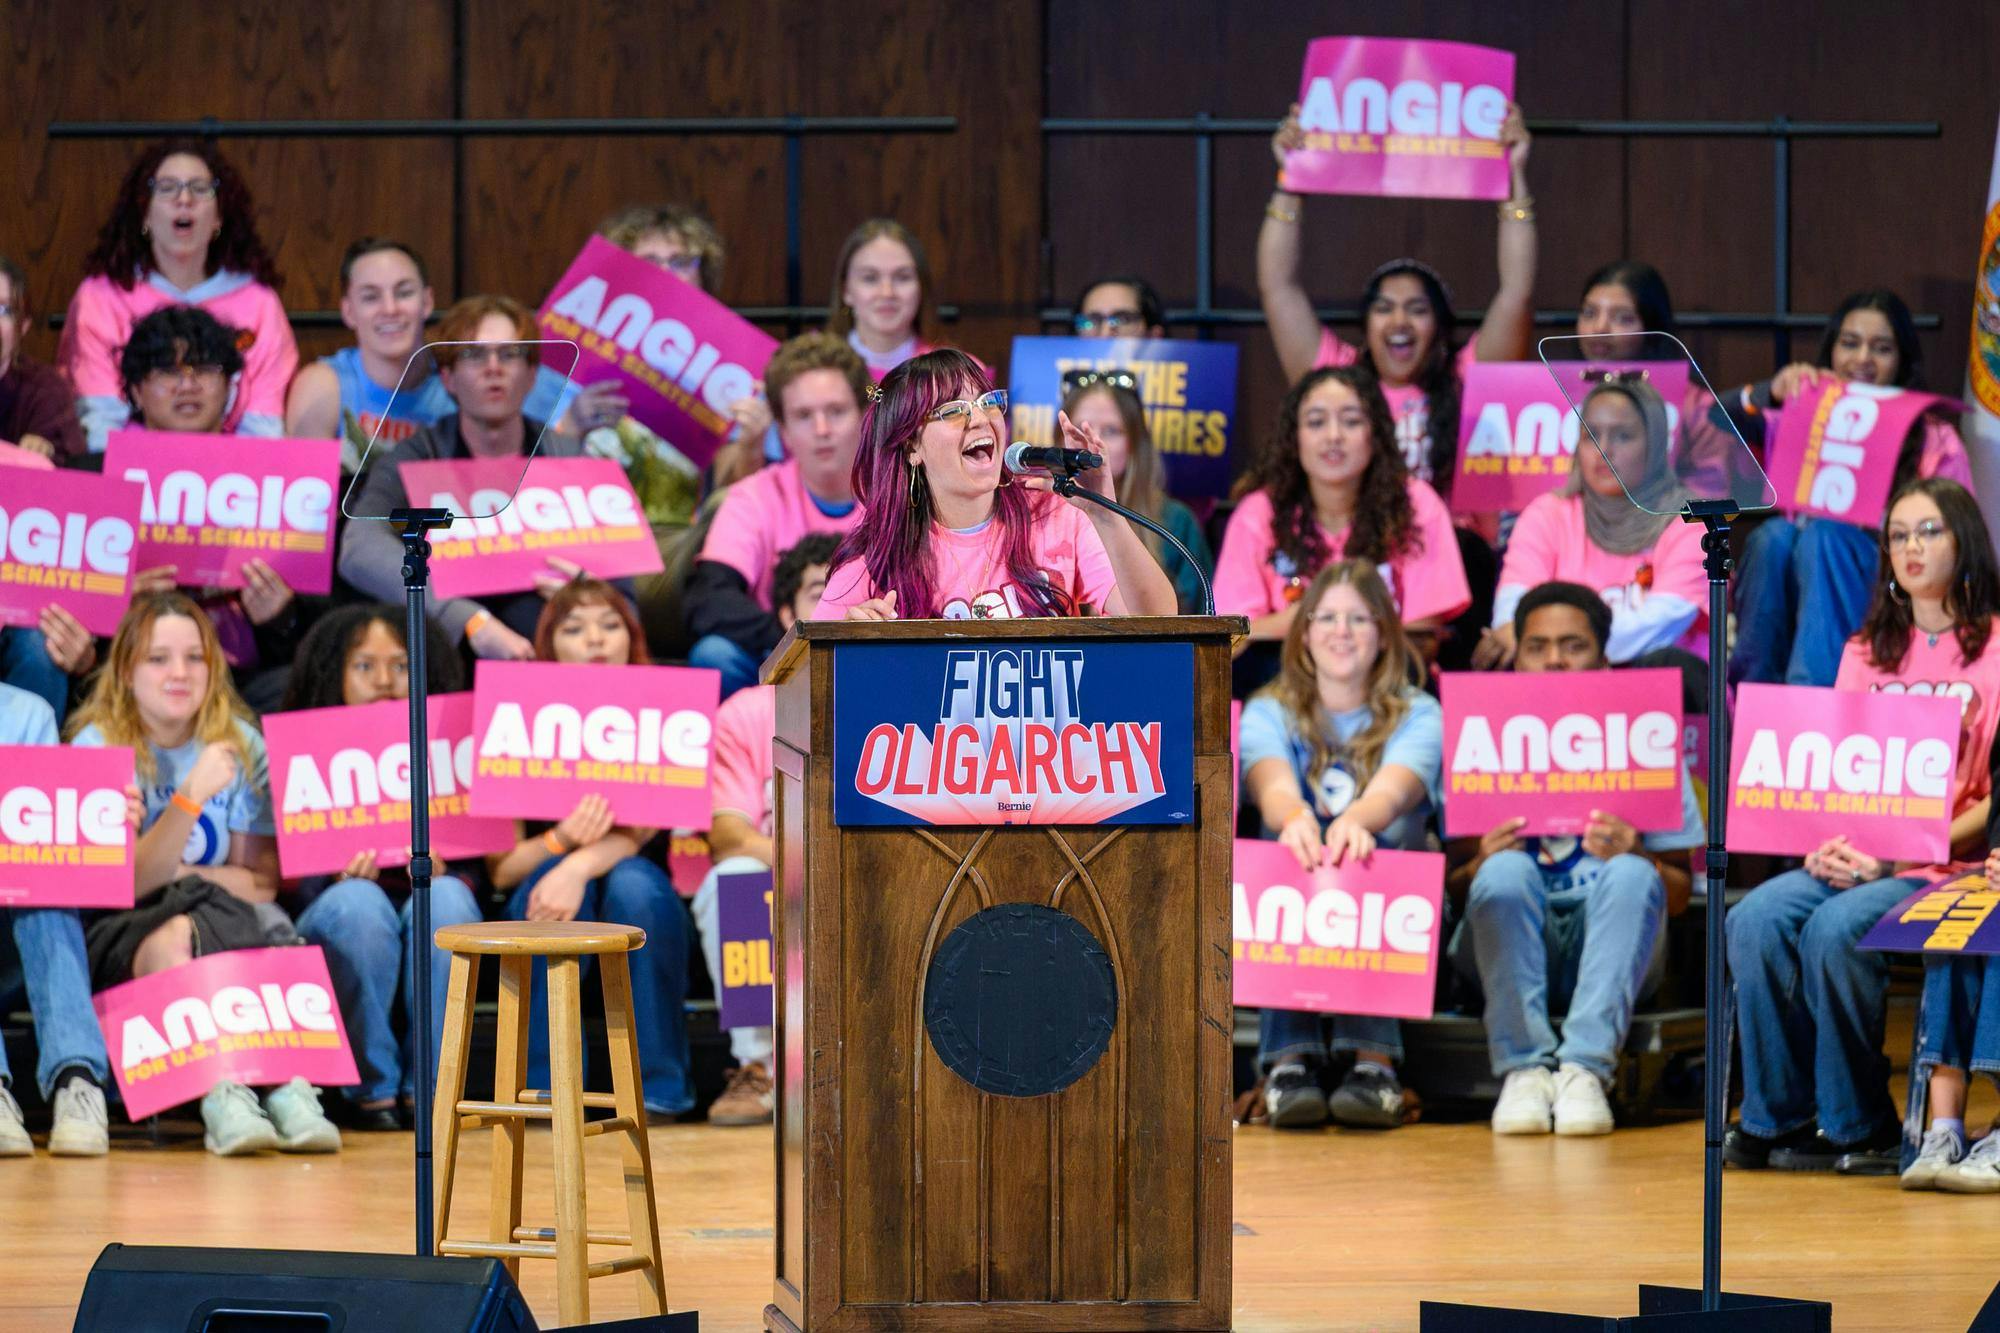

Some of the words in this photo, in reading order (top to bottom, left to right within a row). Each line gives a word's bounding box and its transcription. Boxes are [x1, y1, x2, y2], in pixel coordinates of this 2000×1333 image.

[1300, 77, 1507, 140] ANGIE
[552, 275, 756, 420] ANGIE
[428, 484, 640, 541] ANGIE
[200, 526, 282, 549] SENATE
[1, 561, 82, 592] SENATE
[941, 650, 1084, 719] FIGHT
[480, 702, 712, 768] ANGIE
[1451, 711, 1678, 773] ANGIE
[479, 757, 521, 777] FOR
[527, 759, 572, 778] U.S.
[576, 762, 660, 785] SENATE
[855, 722, 1166, 796] OLIGARCHY
[1737, 729, 1951, 797] ANGIE
[1452, 773, 1495, 793] FOR
[1500, 773, 1542, 793] U.S.
[1546, 771, 1631, 793] SENATE
[1735, 787, 1776, 809] FOR
[1780, 790, 1820, 812] U.S.
[1824, 793, 1904, 817] SENATE
[284, 811, 328, 835] FOR
[331, 806, 375, 829] U.S.
[997, 801, 1032, 811] Bernie
[1251, 944, 1292, 964] U.S.
[1297, 947, 1382, 971] SENATE
[122, 983, 337, 1070] ANGIE
[125, 1062, 168, 1086] FOR
